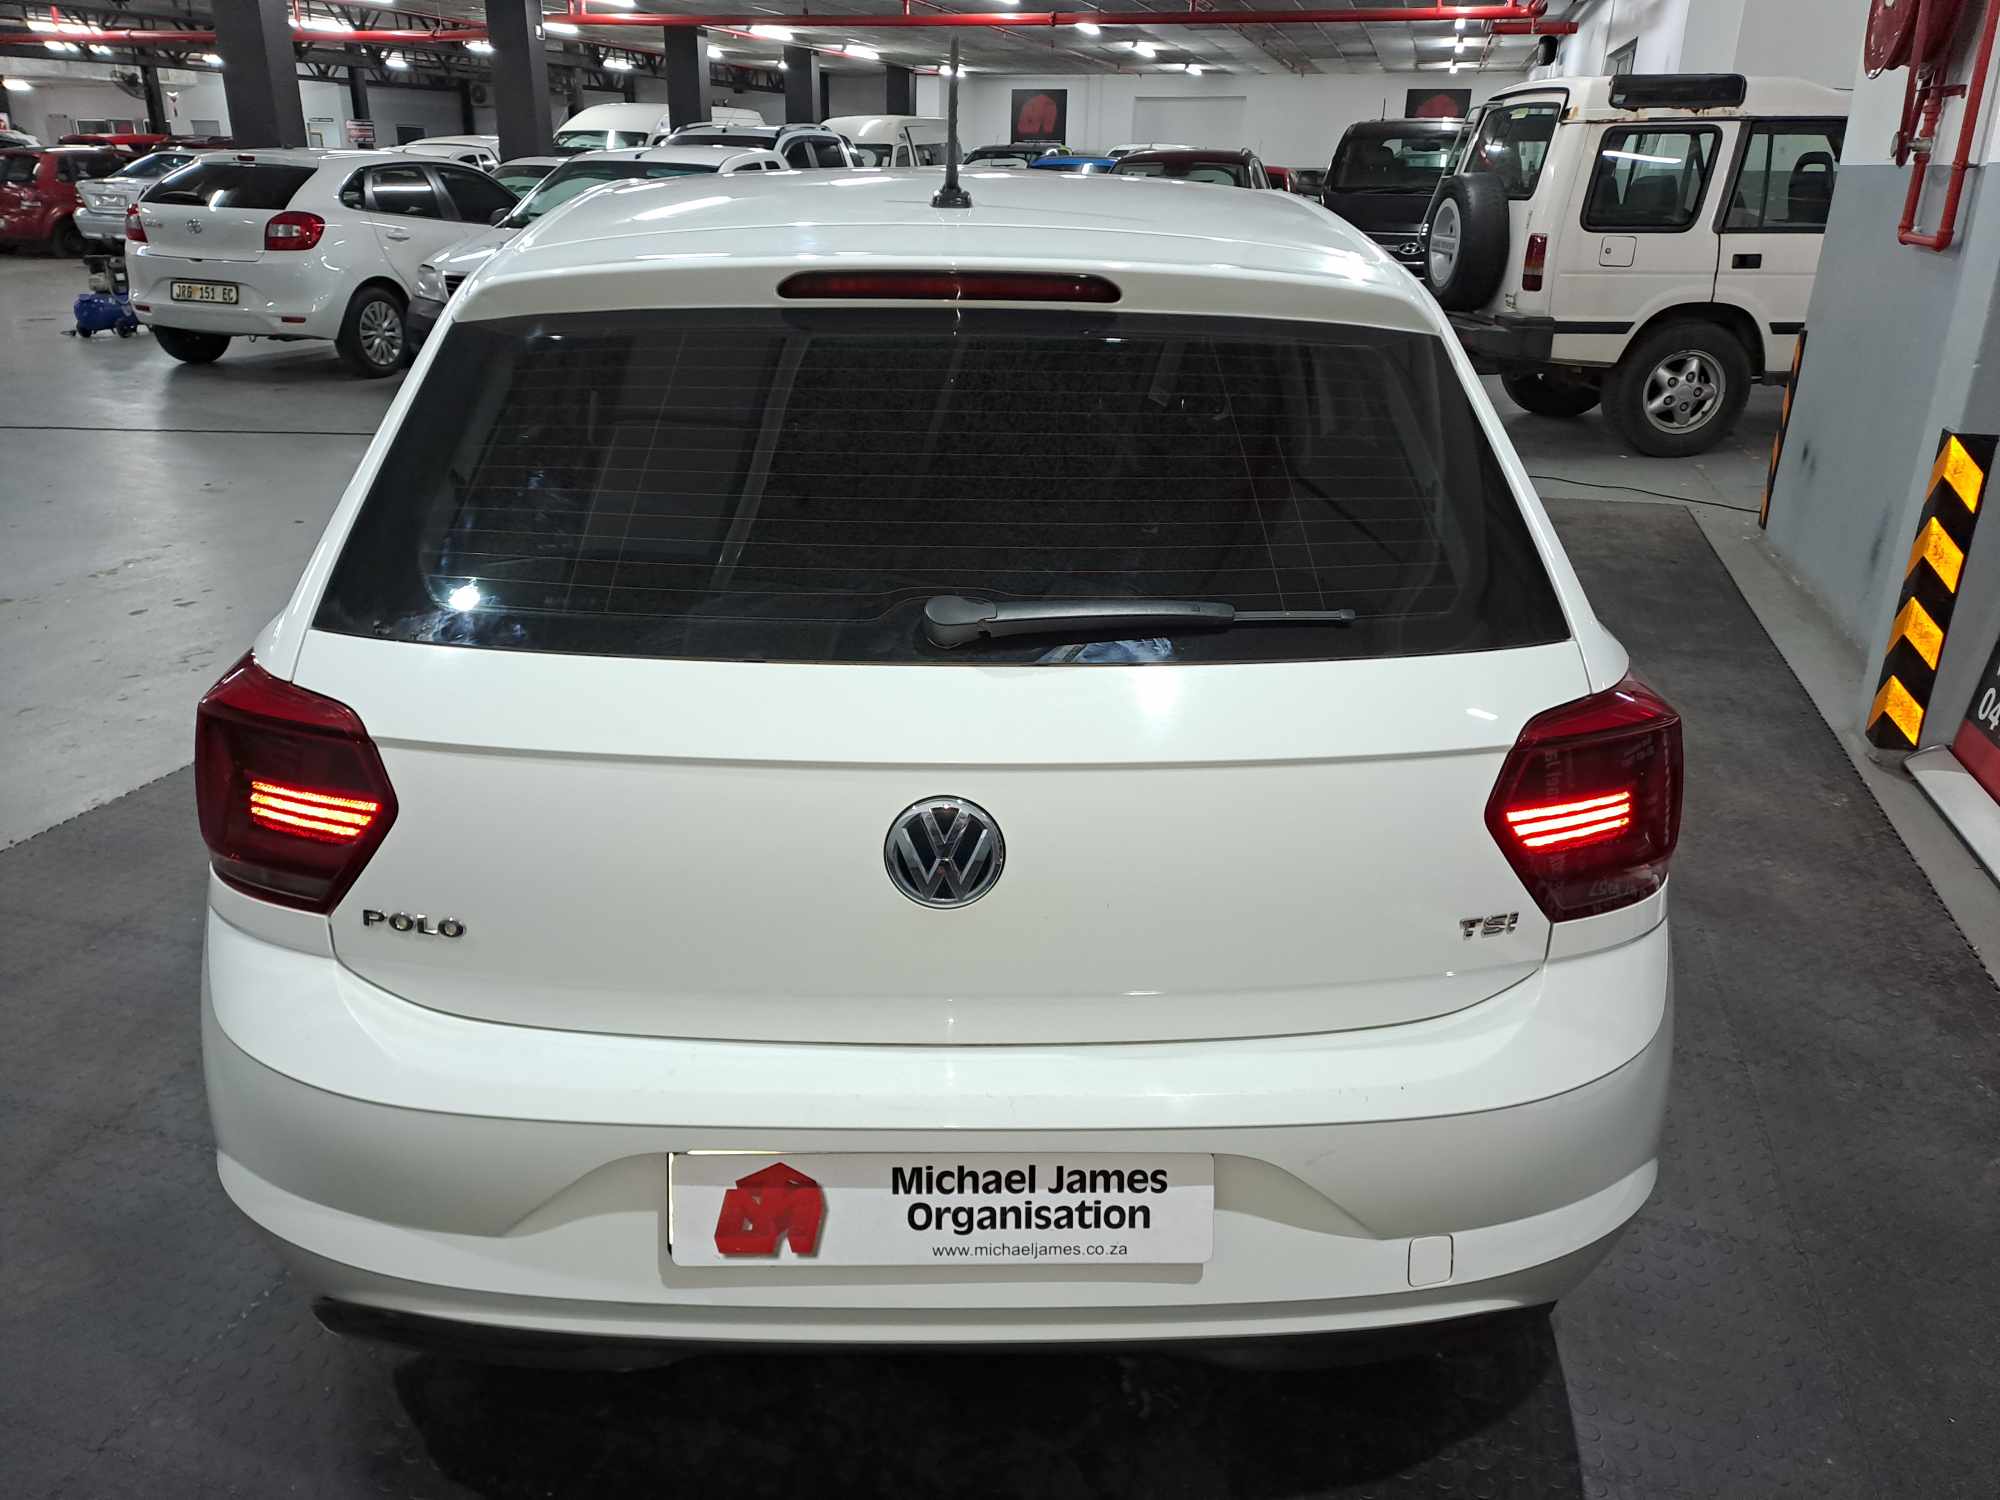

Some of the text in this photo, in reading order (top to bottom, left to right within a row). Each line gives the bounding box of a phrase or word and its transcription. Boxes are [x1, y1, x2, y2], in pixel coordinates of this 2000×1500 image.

[200, 286, 216, 300] 151
[222, 287, 234, 301] EC
[363, 909, 466, 938] POLO
[891, 1164, 1169, 1195] Michael James
[906, 1199, 1152, 1236] Organisation
[931, 1242, 1129, 1260] www.michaeljames.co.za
